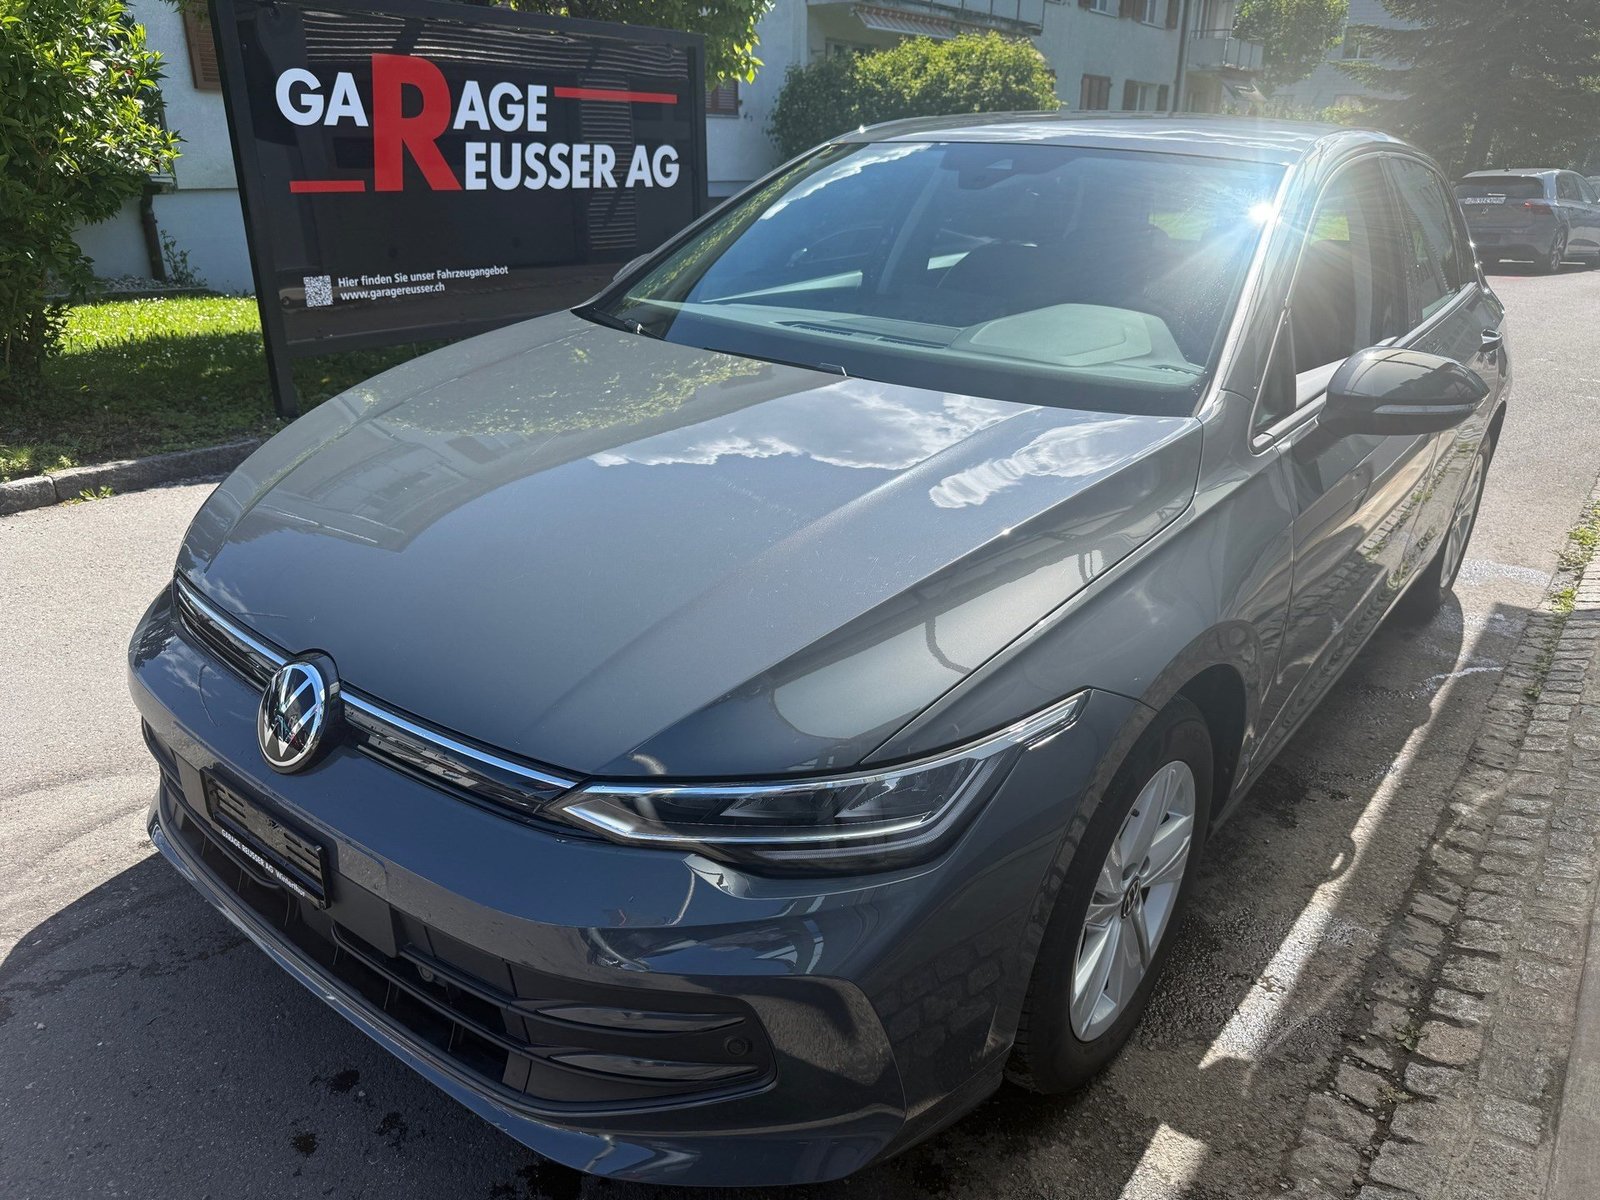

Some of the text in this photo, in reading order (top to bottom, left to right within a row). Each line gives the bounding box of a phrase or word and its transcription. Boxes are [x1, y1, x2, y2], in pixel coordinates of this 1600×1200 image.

[275, 53, 548, 191] GARAGE
[625, 144, 680, 189] AG
[338, 265, 509, 288] Hier finden Sie unser Fahrzeugangebot
[340, 282, 445, 301] www.garagereusser.ch
[221, 829, 242, 849] GARAGE
